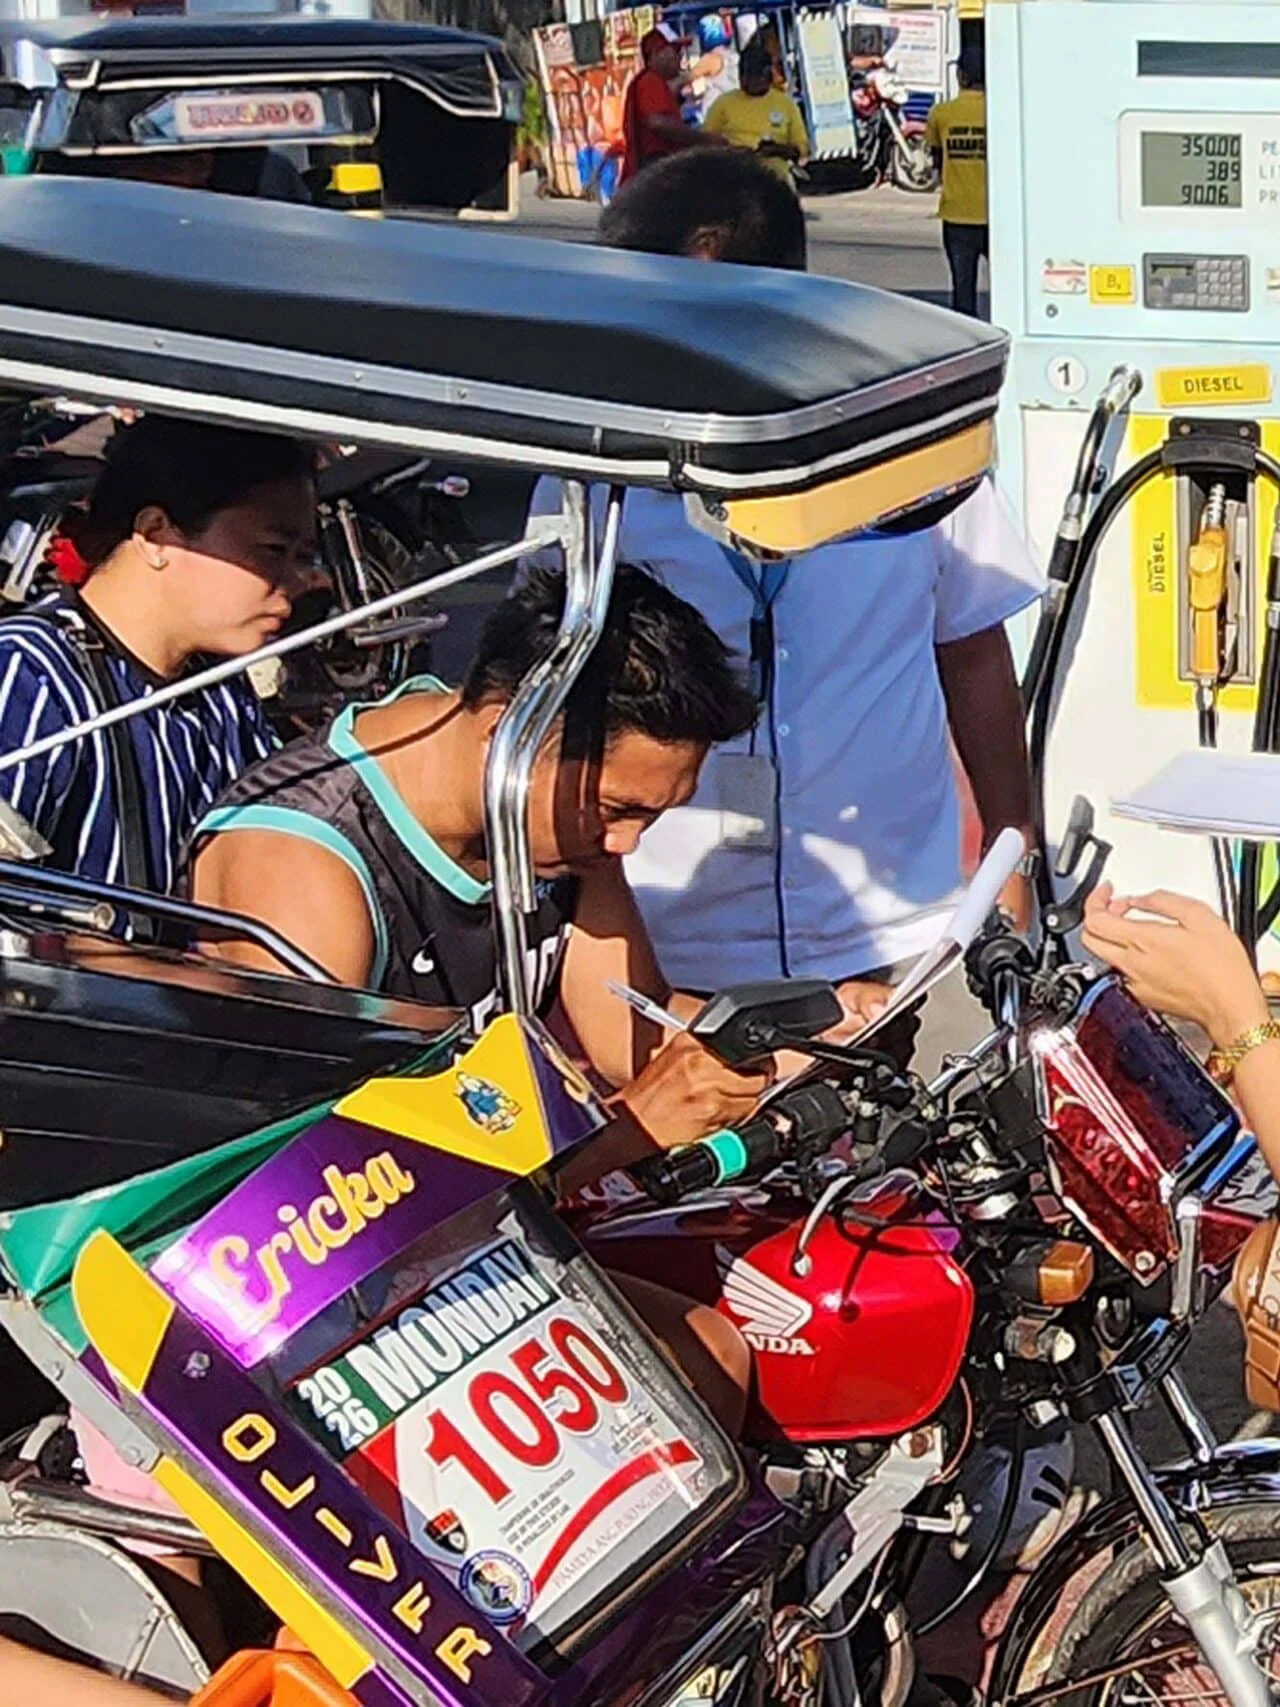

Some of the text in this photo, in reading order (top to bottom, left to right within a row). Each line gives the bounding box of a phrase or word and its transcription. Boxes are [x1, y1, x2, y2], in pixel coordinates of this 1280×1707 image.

[1057, 361, 1071, 386] 1
[1183, 377, 1244, 394] DIESEL
[1152, 531, 1165, 593] DIESEL
[206, 1150, 416, 1328] Ericka
[344, 1243, 551, 1414] MONDAY
[297, 1365, 351, 1419] 20
[424, 1317, 629, 1505] 1050
[325, 1397, 379, 1452] 26
